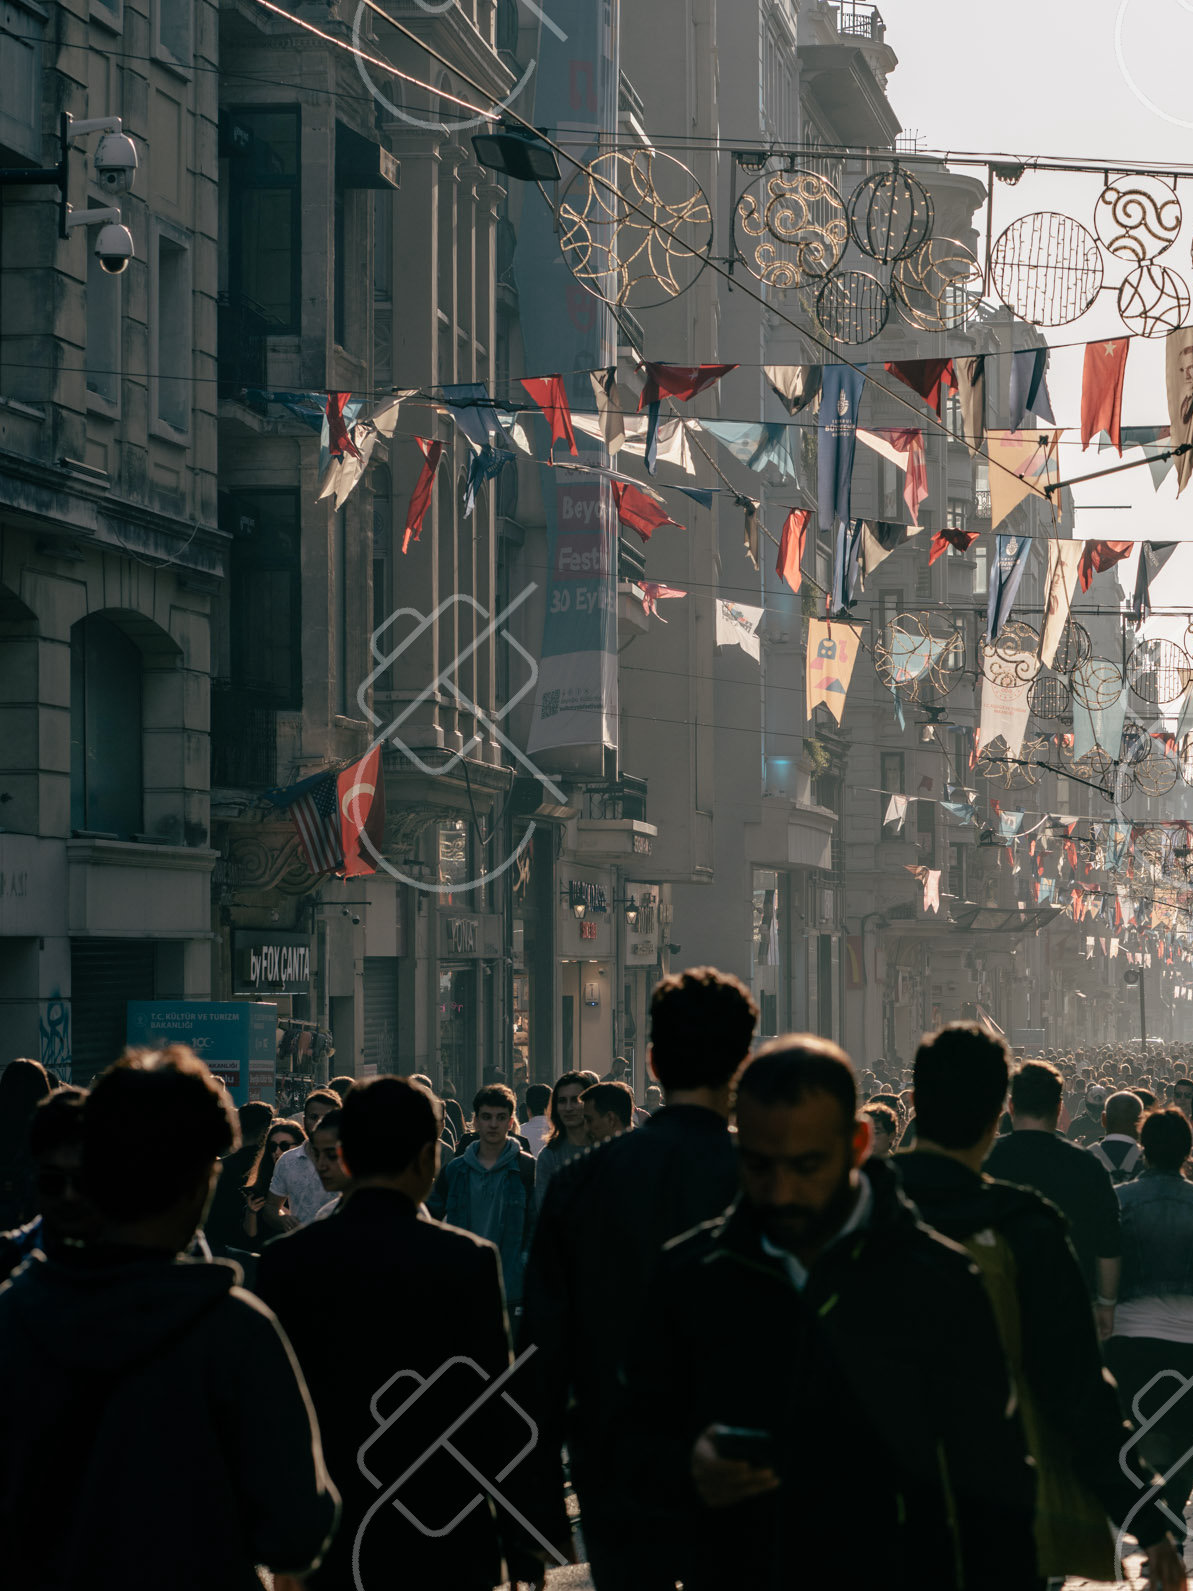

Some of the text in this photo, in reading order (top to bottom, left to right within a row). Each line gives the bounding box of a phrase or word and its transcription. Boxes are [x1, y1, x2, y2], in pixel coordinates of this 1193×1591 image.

[250, 945, 310, 991] by FOX ÇANTA
[165, 1011, 196, 1020] KÜLTÜR
